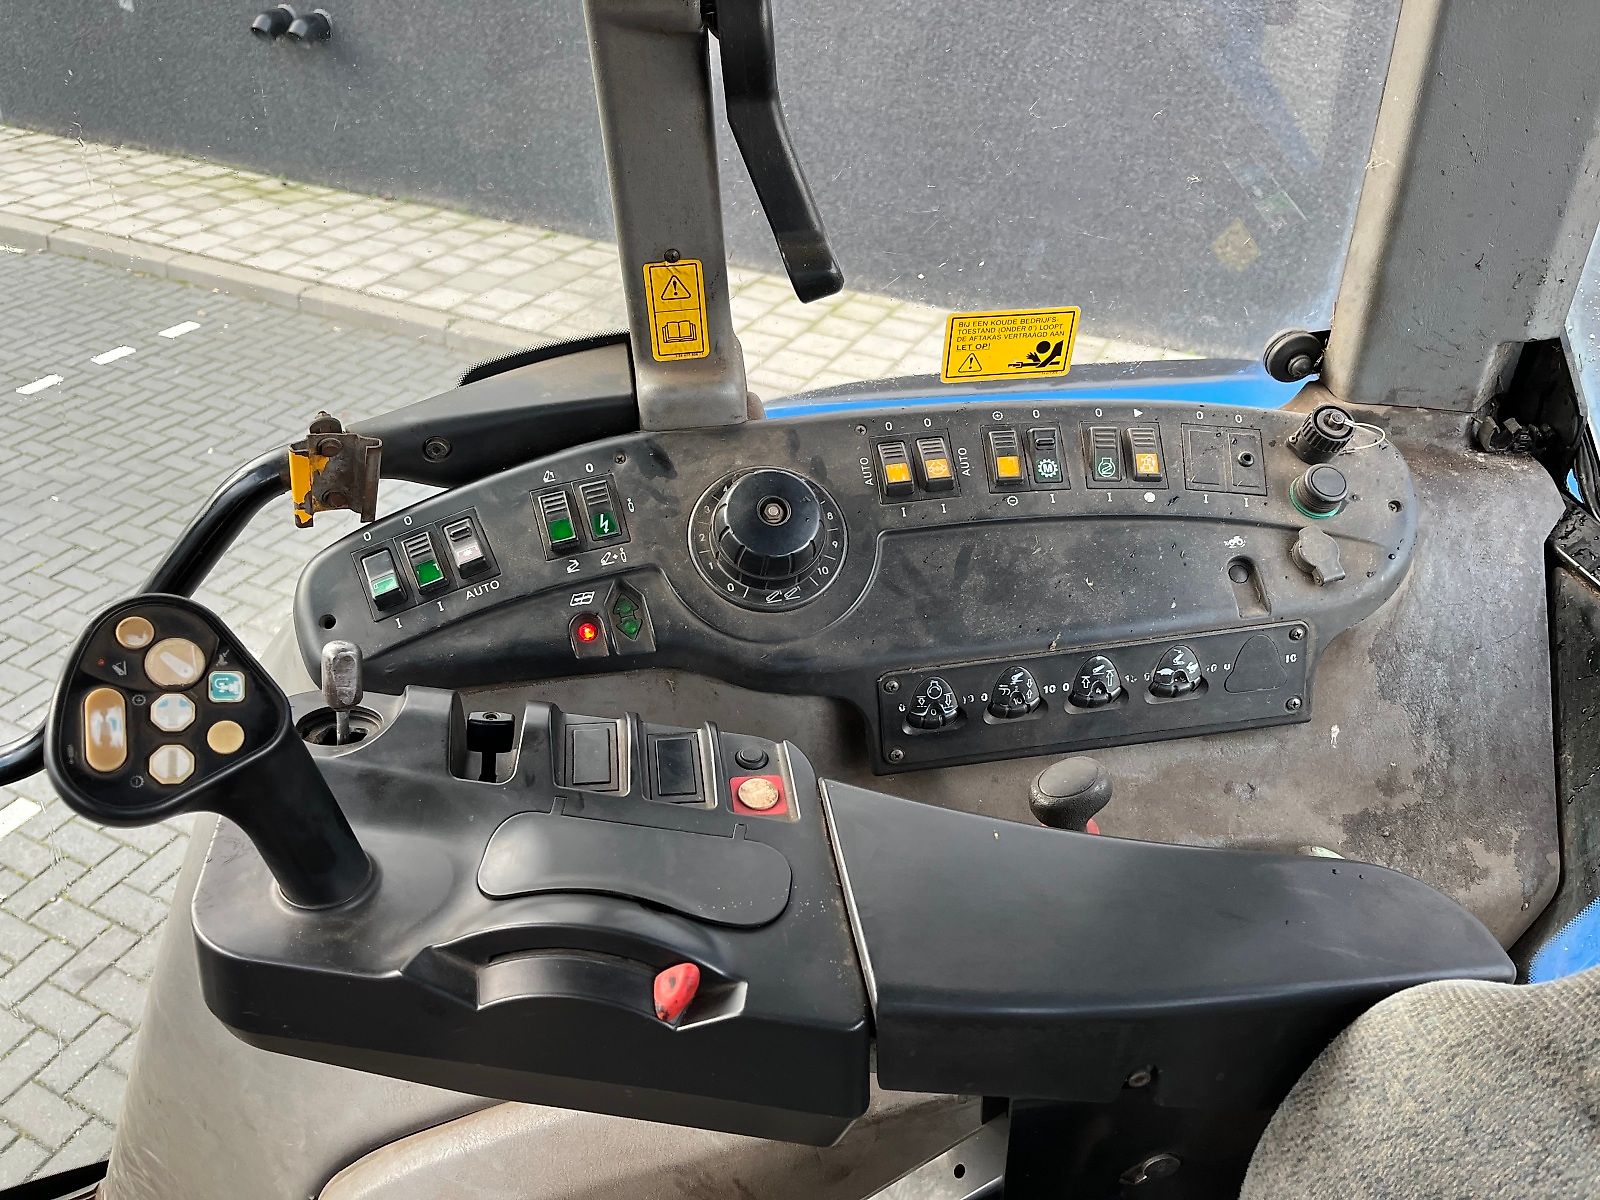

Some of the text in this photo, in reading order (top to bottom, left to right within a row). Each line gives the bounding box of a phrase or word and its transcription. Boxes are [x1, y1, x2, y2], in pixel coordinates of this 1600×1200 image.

[990, 318, 1017, 326] KOUDE
[958, 327, 996, 335] TOESTAND
[998, 325, 1026, 334] (ONDER
[1039, 323, 1063, 331] LOOPT
[968, 334, 1002, 342] AFTAKAS
[1004, 331, 1047, 340] VERTRAAGD
[957, 447, 971, 477] AUTO
[859, 457, 874, 486] AUTO
[826, 512, 834, 520] 8
[699, 534, 706, 542] 2
[831, 541, 839, 549] 9
[708, 562, 714, 570] 1
[817, 566, 829, 575] 10
[465, 579, 501, 601] AUTO
[727, 583, 735, 592] 0
[1043, 684, 1056, 694] 10
[1062, 682, 1070, 692] 0
